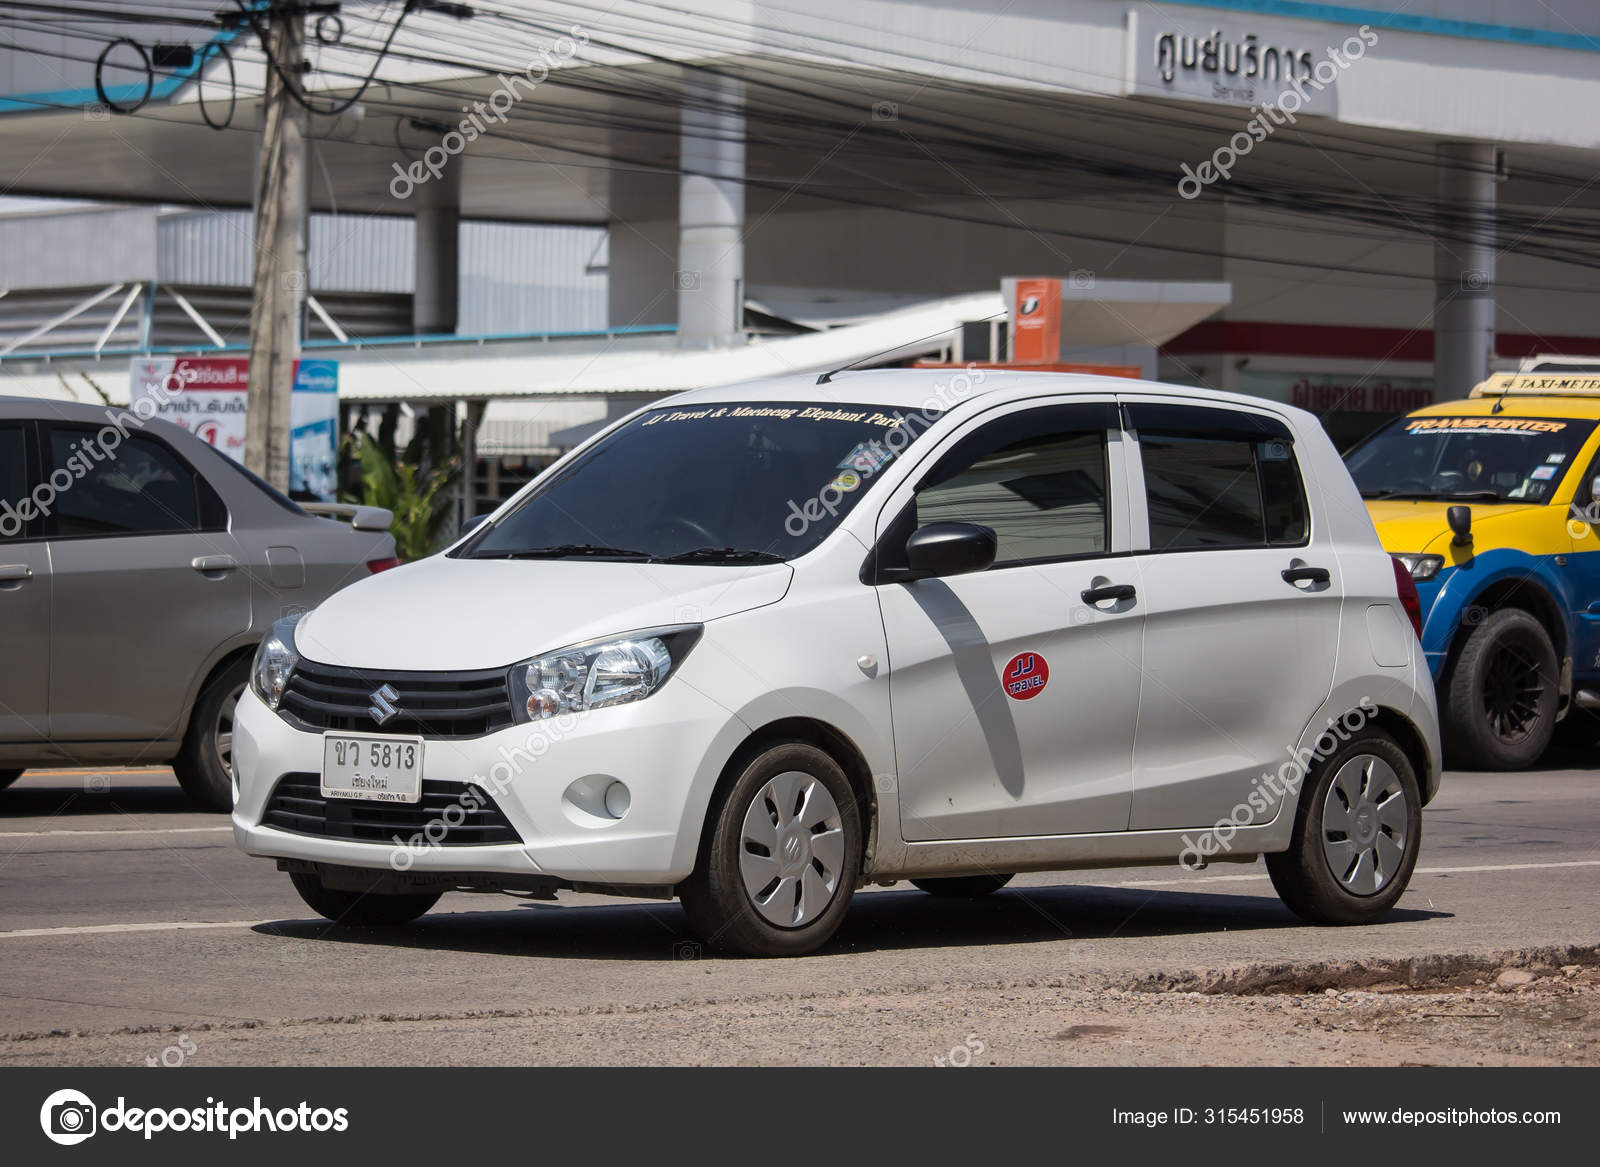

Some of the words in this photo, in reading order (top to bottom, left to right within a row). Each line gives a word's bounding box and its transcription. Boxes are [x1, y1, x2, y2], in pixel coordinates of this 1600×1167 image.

[1155, 28, 1313, 85] ศูนย์บริการ
[1212, 81, 1255, 101] Service
[664, 408, 714, 422] Travel
[709, 407, 728, 418] &
[726, 406, 799, 420] Maetaeng
[797, 406, 867, 421] Elephant
[863, 412, 905, 428] Park
[1405, 418, 1568, 433] TRANSPORTER
[1011, 655, 1034, 678] JJ
[370, 742, 415, 769] 5813
[351, 773, 388, 789] เชียงใหม่
